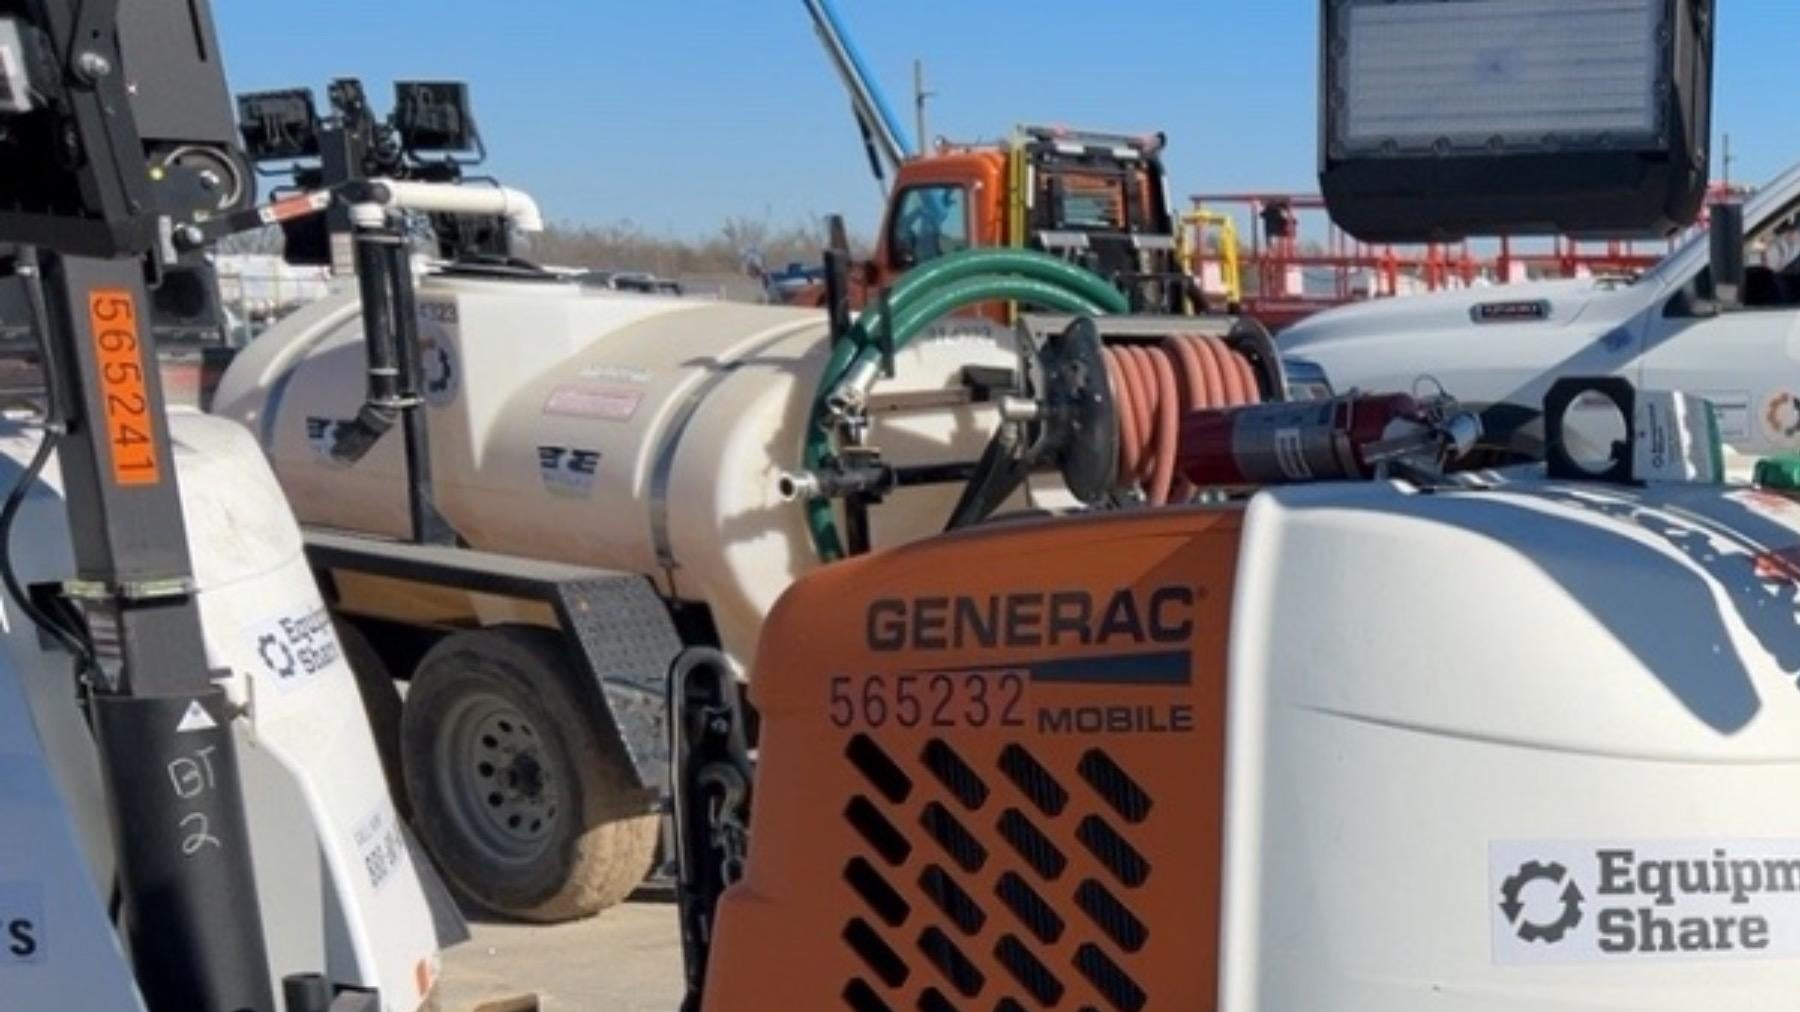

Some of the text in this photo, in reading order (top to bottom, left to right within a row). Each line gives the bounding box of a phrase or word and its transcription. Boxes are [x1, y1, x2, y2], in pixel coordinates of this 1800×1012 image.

[93, 297, 155, 472] 565241
[866, 587, 1195, 652] GENERAC
[829, 673, 1027, 729] 565232
[1037, 704, 1195, 734] MOBILE
[1596, 906, 1771, 953] Share
